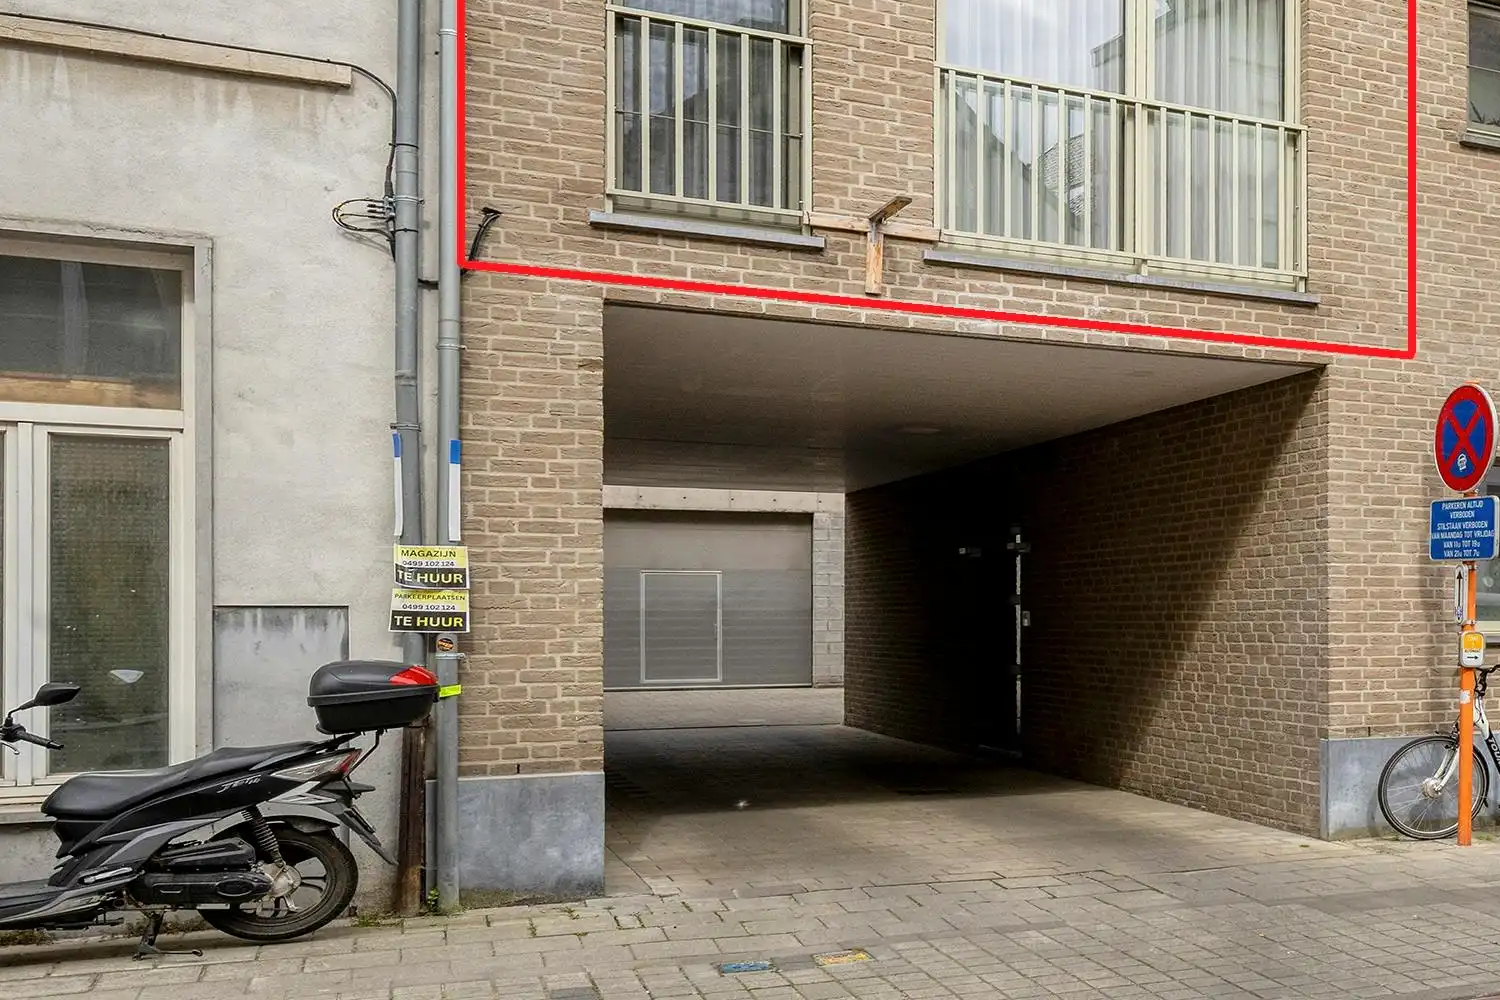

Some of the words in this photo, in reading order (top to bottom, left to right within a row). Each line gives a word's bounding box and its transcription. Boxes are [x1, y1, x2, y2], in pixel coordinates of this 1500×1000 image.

[1441, 501, 1467, 510] PARKEREN
[1450, 510, 1475, 519] VERBODEN
[1437, 522, 1461, 530] STILSTAAN
[1462, 520, 1488, 529] VERBODEN
[1440, 531, 1463, 539] MAANDAG
[1463, 530, 1473, 538] TOT
[1473, 529, 1495, 538] VRIJDAG
[1462, 540, 1471, 548] TOT
[401, 549, 456, 558] MAGAZIJN
[1443, 550, 1453, 558] VAN
[1462, 549, 1472, 557] TOT
[397, 570, 413, 582] TE
[416, 572, 463, 583] HUUR
[394, 593, 465, 601] PARKEERPLAATSEN
[394, 615, 412, 627] TE
[416, 616, 463, 627] HUUR
